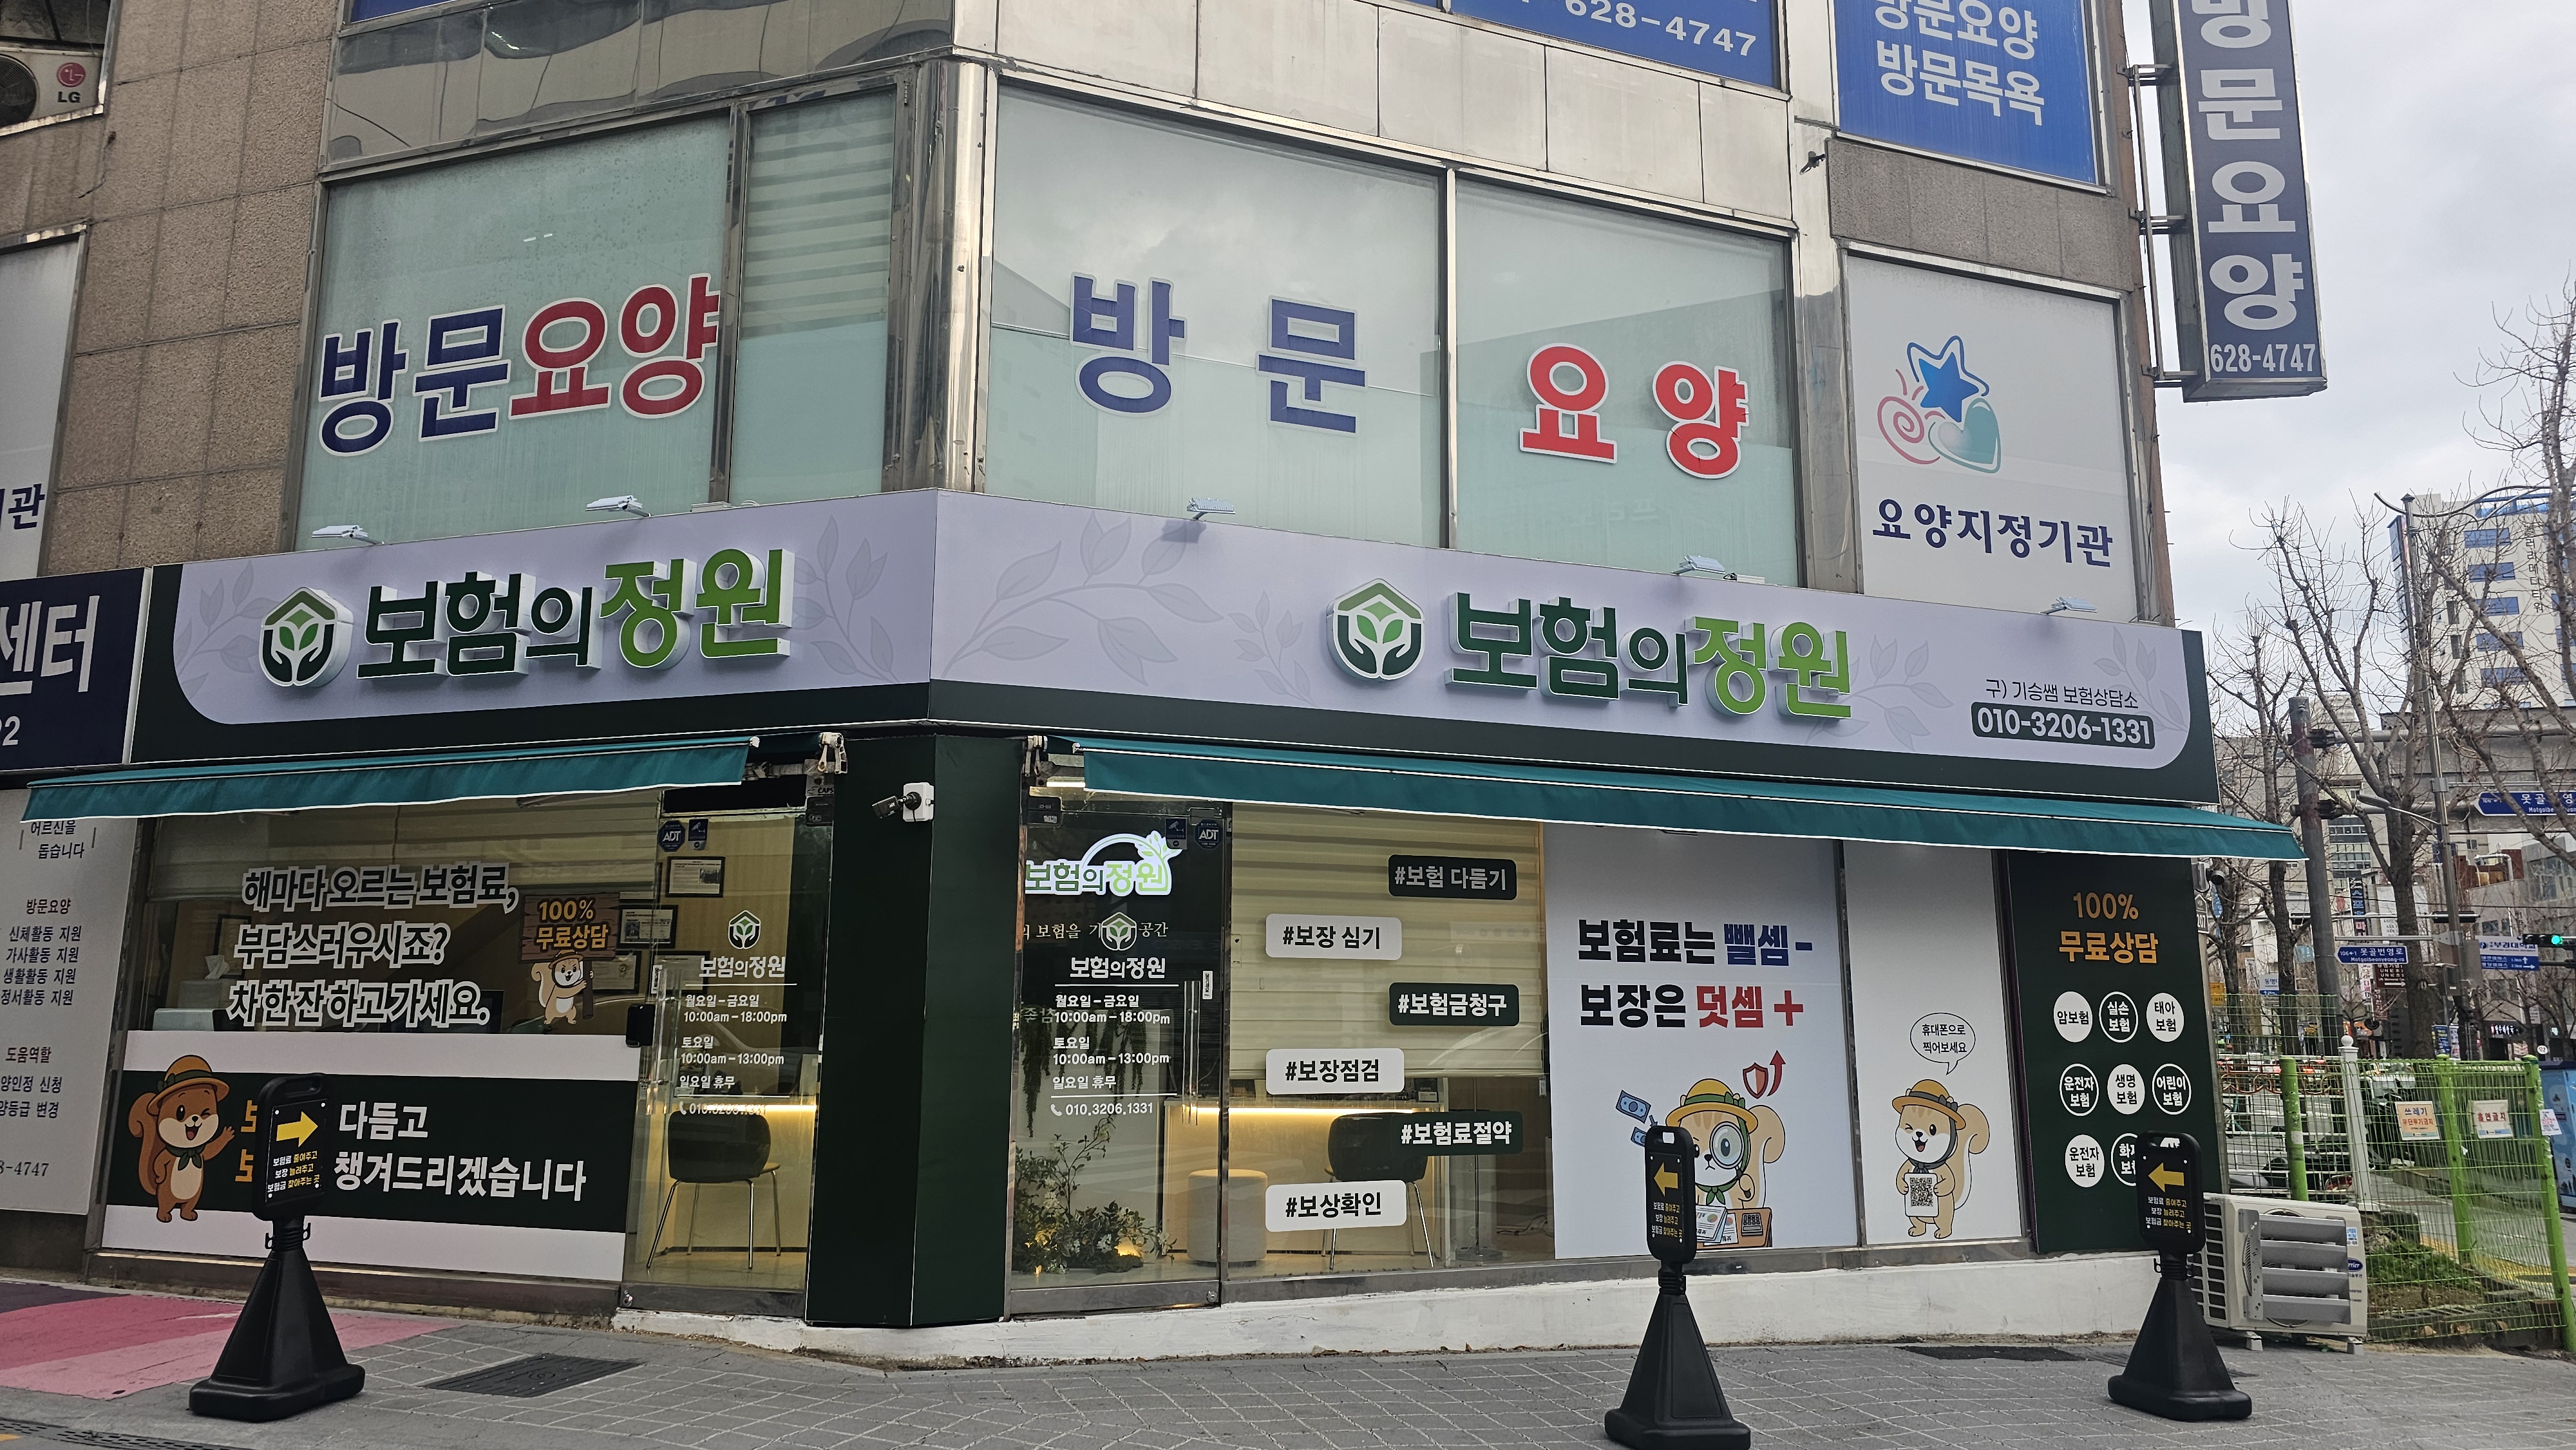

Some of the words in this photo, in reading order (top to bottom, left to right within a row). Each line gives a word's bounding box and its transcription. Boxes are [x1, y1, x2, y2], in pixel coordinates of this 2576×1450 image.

[1877, 40, 2045, 126] 방문목욕
[58, 91, 80, 104] LG
[2210, 343, 2315, 372] 628-4747
[0, 484, 45, 530] 관
[1873, 499, 2113, 567] 요양지정기관
[356, 549, 794, 679] 보험의정원
[1444, 592, 1852, 719] 보험의정원
[1985, 679, 2007, 699] 구)
[2012, 682, 2058, 702] 기승쌤
[2063, 686, 2139, 708] 보험상담소
[1978, 708, 2150, 744] 010-3206-1331
[662, 831, 681, 842] ADT
[1198, 829, 1219, 840] ADT
[39, 842, 84, 859] 돕습니다
[1395, 865, 1444, 888] #보험
[1450, 868, 1507, 890] 다듬기
[26, 898, 71, 914] 방문요양
[538, 899, 594, 923] 100%
[2073, 892, 2139, 920] 100%
[2197, 914, 2206, 928] 207
[9, 926, 53, 942] 신체활동
[59, 925, 82, 942] 지원
[536, 924, 609, 950] 무료상담
[1036, 923, 1081, 939] 보험을
[1139, 921, 1169, 937] 공간
[1283, 926, 1336, 948] #보장
[1341, 926, 1381, 950] 심기
[236, 923, 450, 967] 부담스러우시죠?
[1578, 919, 1716, 965] 보험료는
[2059, 930, 2159, 964] 무료상담
[6, 946, 51, 963] 가사활동
[56, 946, 79, 963] 지원
[2360, 948, 2404, 956] 못골번영로
[53, 968, 77, 984] 지원
[699, 956, 786, 979] 보험의정원
[1070, 956, 1166, 979] 보험의정원
[0, 989, 45, 1006] 정서활동
[51, 989, 74, 1006] 지원
[1398, 993, 1508, 1017] #보험금청구
[1580, 984, 1686, 1028] 보장은
[2107, 1001, 2129, 1015] 실손
[2154, 1001, 2175, 1015] 태아
[2056, 1010, 2090, 1026] 암보험
[2108, 1017, 2130, 1033] 보험
[2155, 1017, 2177, 1033] 보험
[1922, 1024, 1966, 1036] 휴대폰으로
[681, 1036, 714, 1049] 토요일
[1053, 1037, 1090, 1050] 토요일
[1923, 1042, 1967, 1054] 찍어보세요
[5, 1046, 52, 1064] 도움역할
[1285, 1059, 1380, 1083] #보장점검
[39, 1076, 62, 1094] 신청
[679, 1075, 711, 1089] 일요일
[713, 1075, 735, 1089] 휴무
[1052, 1076, 1088, 1090] 일요일
[1092, 1075, 1117, 1089] 휴무
[2063, 1076, 2094, 1092] 운전자
[2116, 1073, 2136, 1089] 생명
[2156, 1075, 2186, 1091] 어린이
[2070, 1092, 2090, 1108] 보험
[2116, 1089, 2137, 1106] 보험
[2163, 1091, 2183, 1107] 보험
[37, 1101, 59, 1119] 변경
[339, 1100, 428, 1140] 다듬고
[1401, 1121, 1513, 1146] #보험료절약
[273, 1155, 292, 1167] 보험료
[2069, 1146, 2099, 1163] 운전자
[275, 1169, 288, 1178] 보장
[334, 1151, 587, 1201] 챙겨드리겠습니다
[2076, 1163, 2096, 1178] 보험
[2121, 1160, 2136, 1175] 보
[267, 1181, 286, 1192] 보험금
[1285, 1192, 1381, 1218] #보상확인
